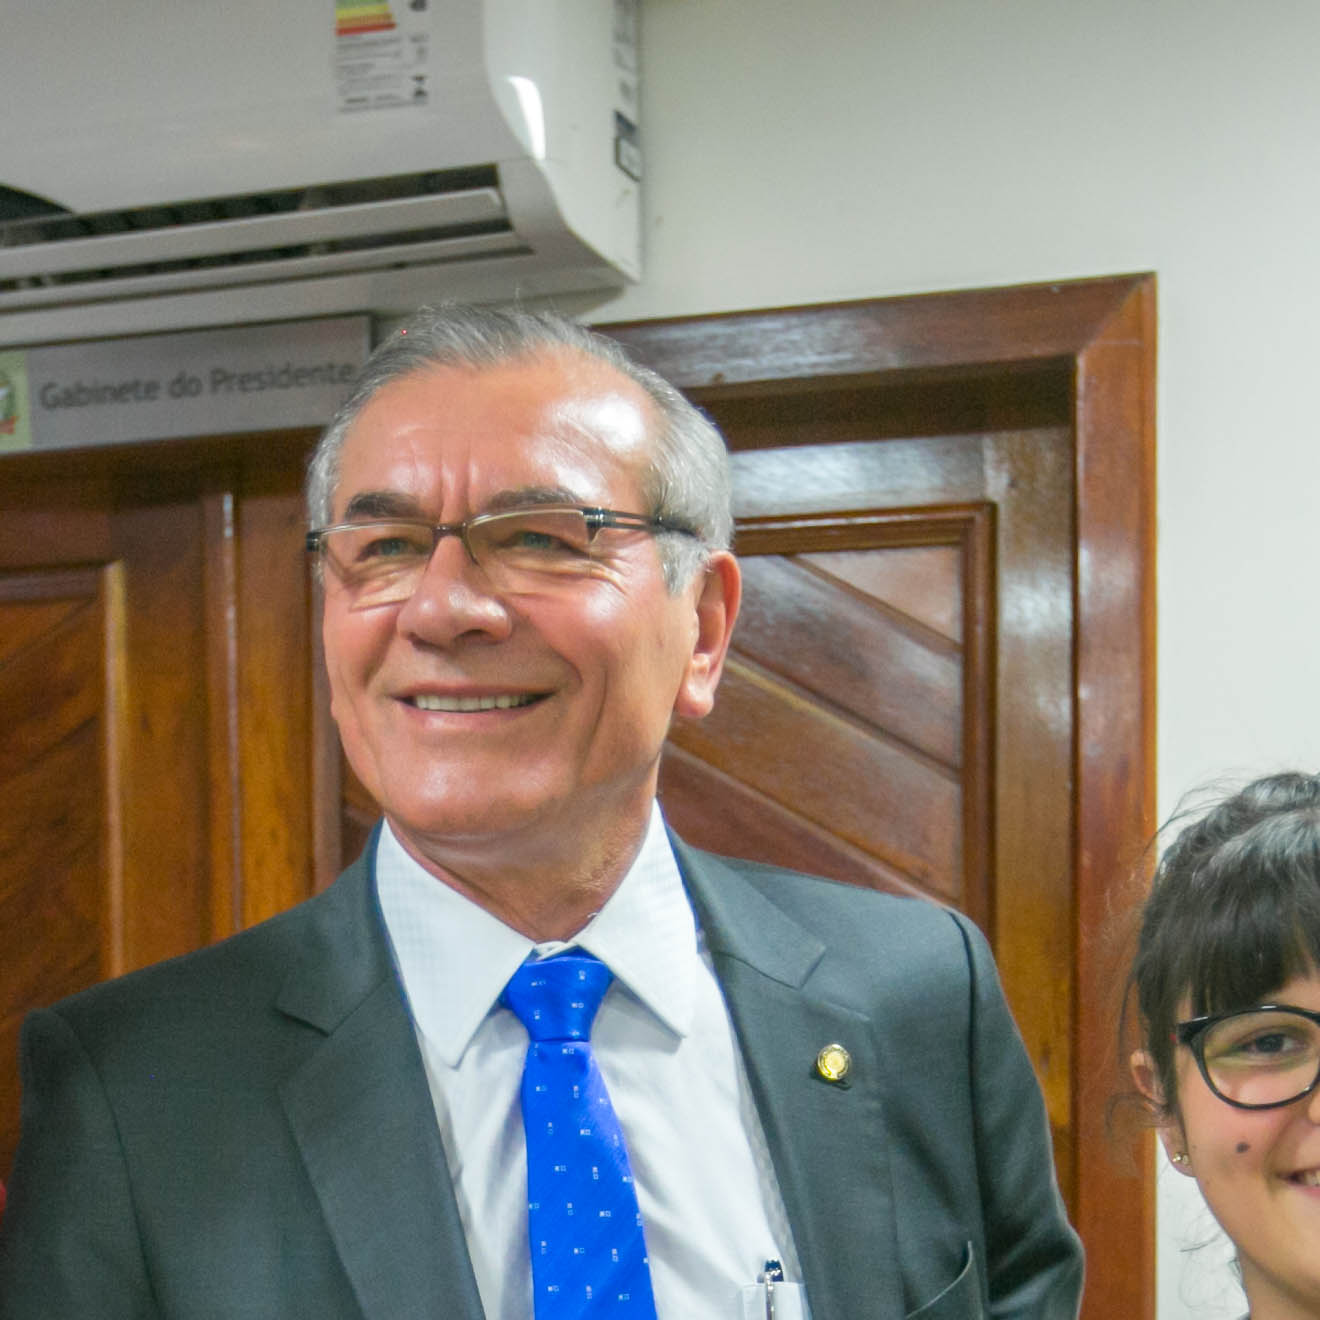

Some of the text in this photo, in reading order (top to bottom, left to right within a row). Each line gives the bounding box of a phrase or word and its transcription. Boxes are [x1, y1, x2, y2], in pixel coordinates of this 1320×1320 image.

[40, 360, 356, 411] Gabinete do Presidente
